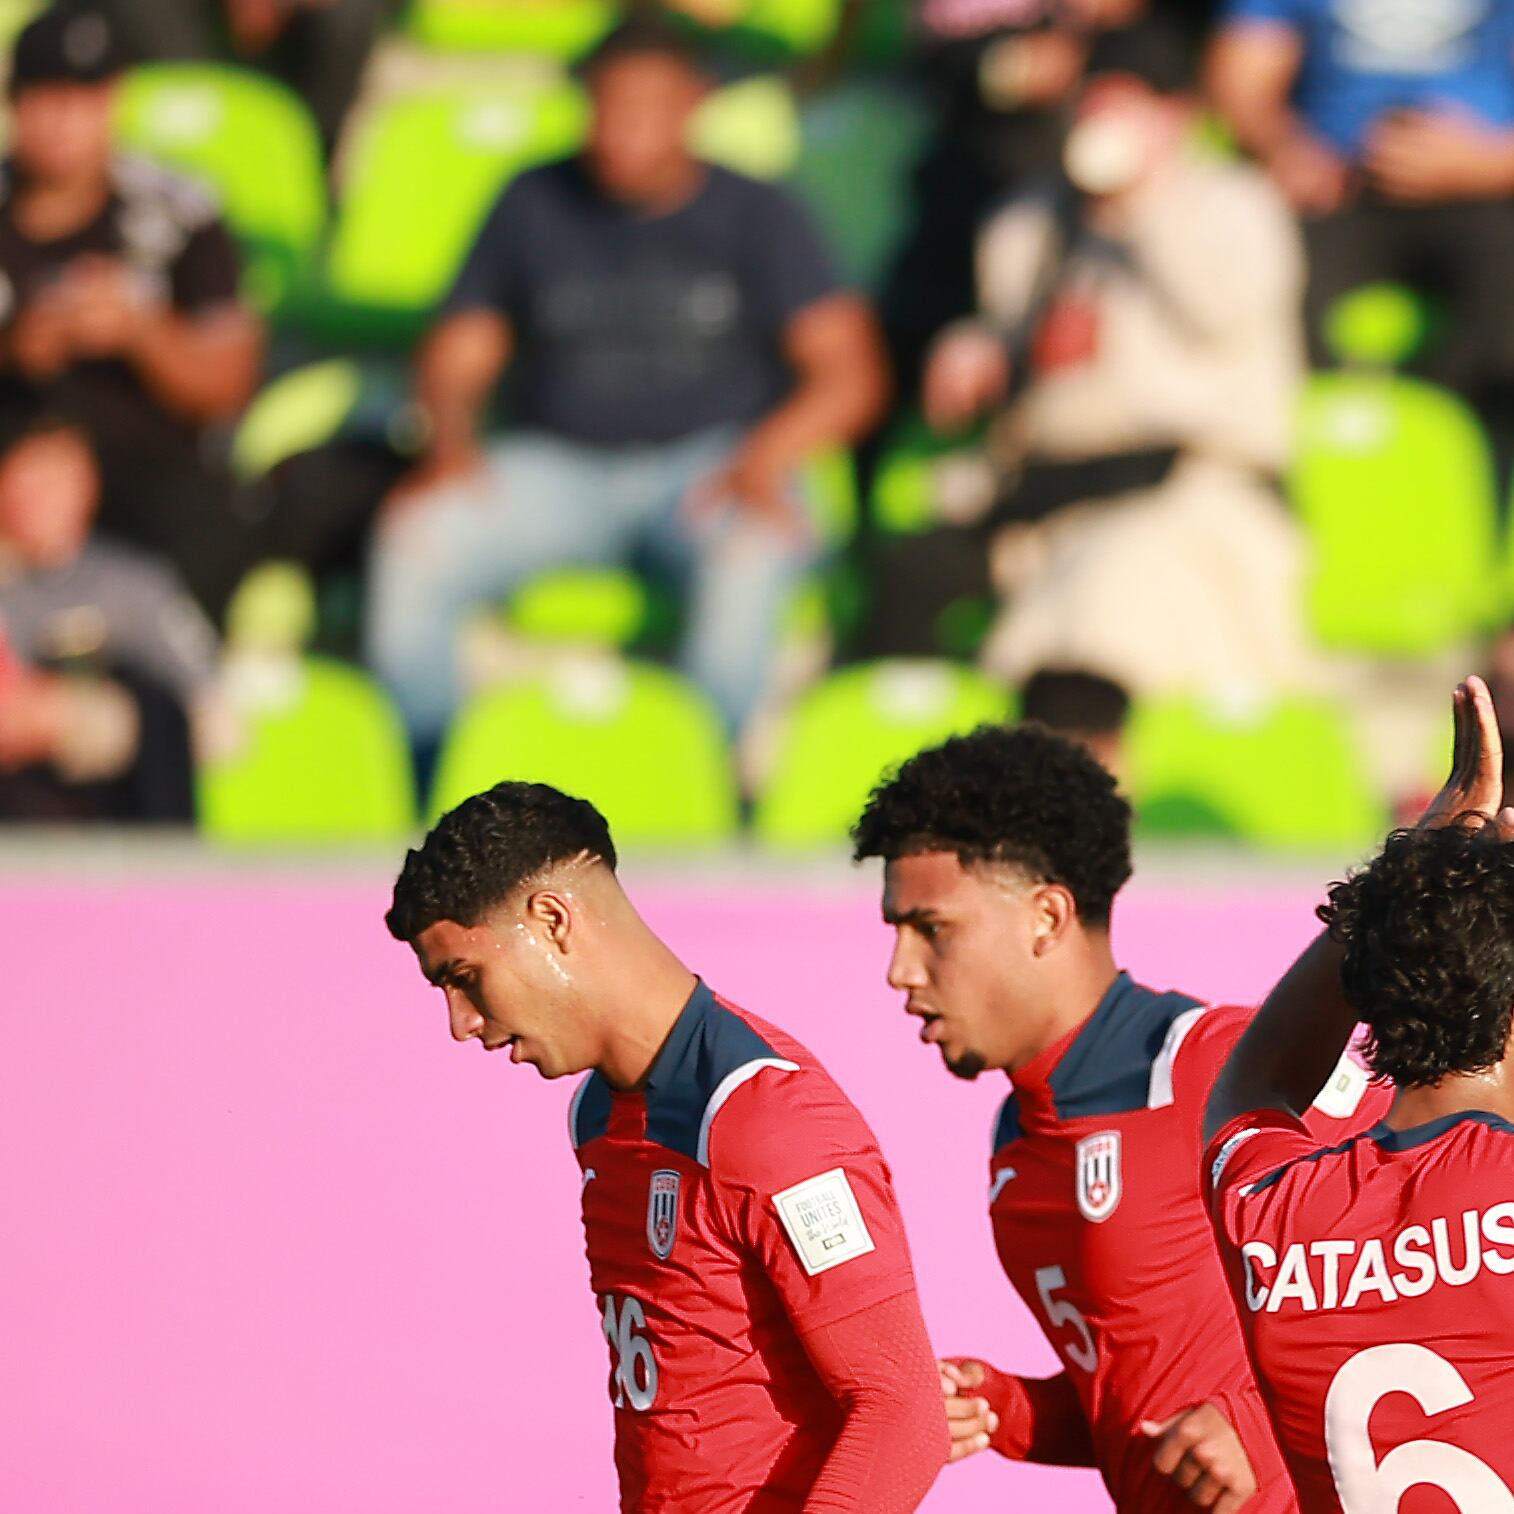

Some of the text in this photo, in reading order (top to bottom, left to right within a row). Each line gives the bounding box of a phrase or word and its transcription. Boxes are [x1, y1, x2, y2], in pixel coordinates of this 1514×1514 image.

[800, 1200, 842, 1228] UNITES
[602, 1294, 658, 1412] 16
[1035, 1265, 1099, 1373] 5
